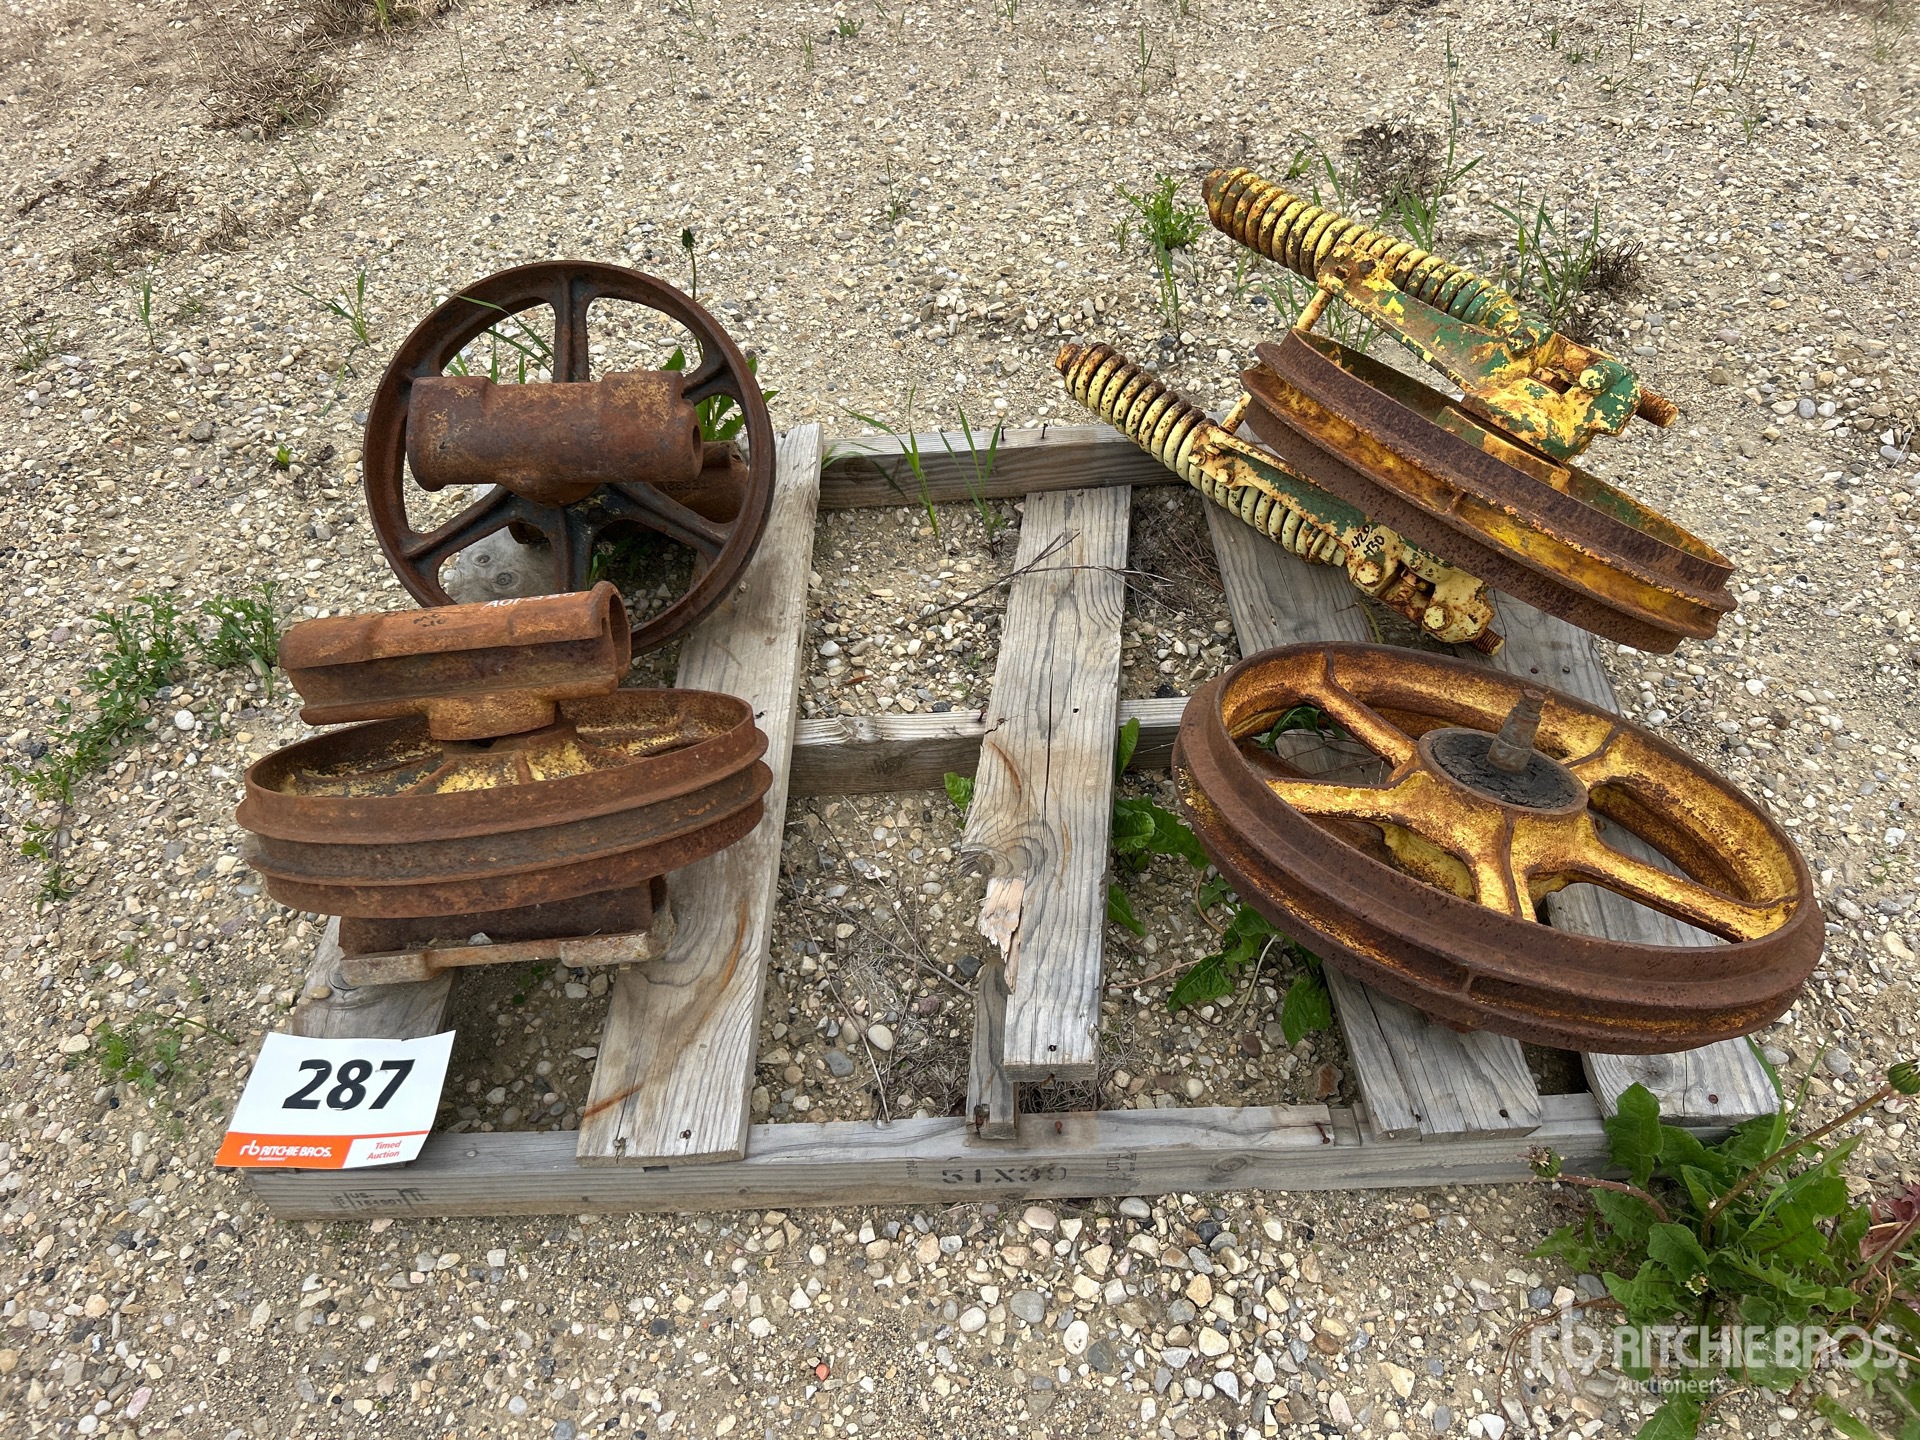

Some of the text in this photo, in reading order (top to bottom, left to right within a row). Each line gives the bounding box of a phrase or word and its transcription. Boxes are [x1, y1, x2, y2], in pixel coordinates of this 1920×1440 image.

[281, 1058, 416, 1111] 287
[375, 1140, 402, 1150] Timed
[259, 1145, 300, 1156] RITCHIE
[299, 1146, 332, 1158] BROS.
[366, 1150, 400, 1160] Auction
